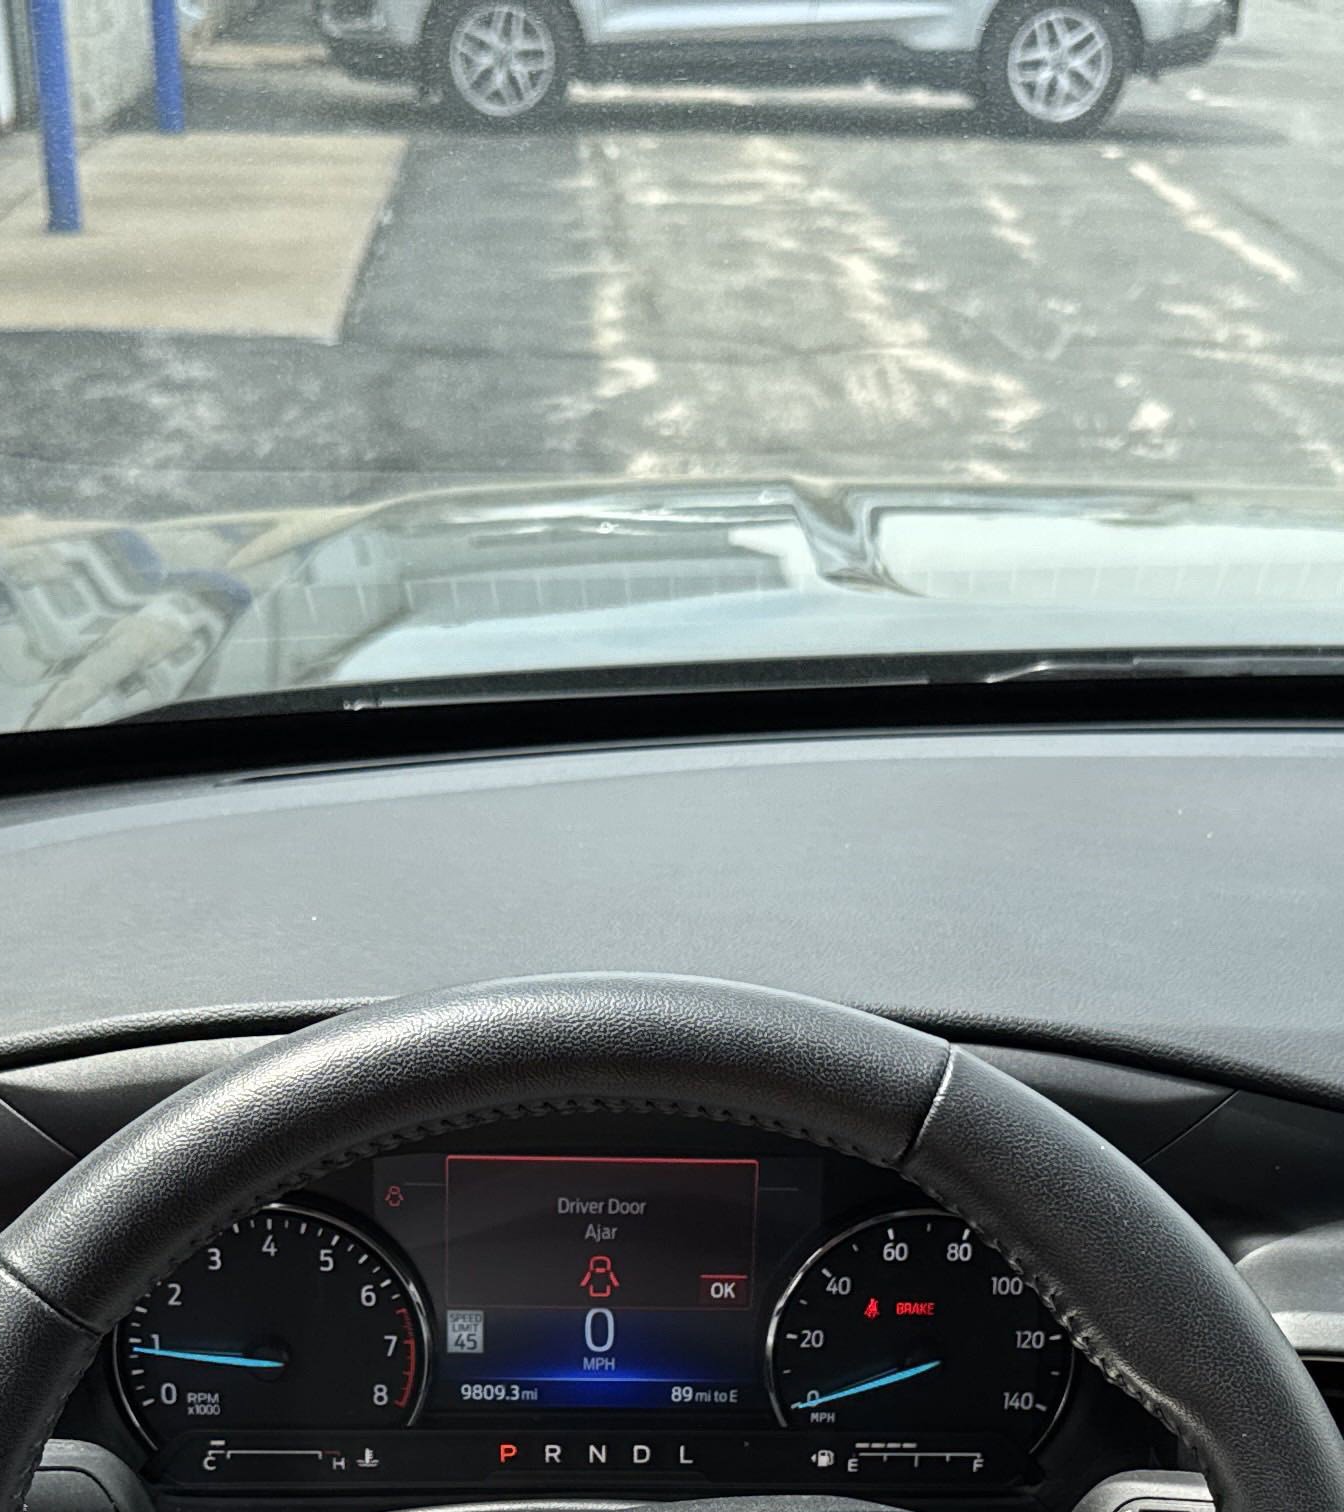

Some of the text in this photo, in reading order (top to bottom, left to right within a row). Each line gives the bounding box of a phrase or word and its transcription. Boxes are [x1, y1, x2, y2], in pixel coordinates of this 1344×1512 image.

[557, 1197, 647, 1215] Driver Door
[585, 1224, 618, 1242] Ajar
[261, 1235, 278, 1257] 4
[882, 1242, 909, 1262] 60
[946, 1242, 972, 1262] 80
[207, 1248, 223, 1271] 3
[319, 1249, 335, 1272] 5
[167, 1283, 182, 1306] 2
[709, 1282, 737, 1299] OK
[825, 1276, 852, 1296] 40
[990, 1276, 1024, 1296] 100
[360, 1284, 377, 1307] 6
[449, 1313, 482, 1323] SPEED
[896, 1302, 935, 1316] BRAKE
[452, 1323, 479, 1333] LIMIT
[584, 1307, 615, 1352] 0
[384, 1336, 398, 1357] 7
[454, 1333, 478, 1350] 45
[799, 1330, 824, 1348] 20
[1015, 1330, 1045, 1349] 120
[583, 1357, 616, 1371] MPH
[160, 1383, 177, 1405] 0
[187, 1392, 220, 1404] RPM
[373, 1384, 389, 1407] 8
[713, 1389, 728, 1402] to
[729, 1390, 739, 1403] E
[806, 1390, 821, 1407] 0
[1003, 1391, 1034, 1411] 140
[187, 1404, 221, 1416] x1000
[810, 1412, 835, 1424] MPH
[202, 1456, 346, 1471] C H
[500, 1445, 693, 1464] P R N D L
[847, 1459, 984, 1472] E F
